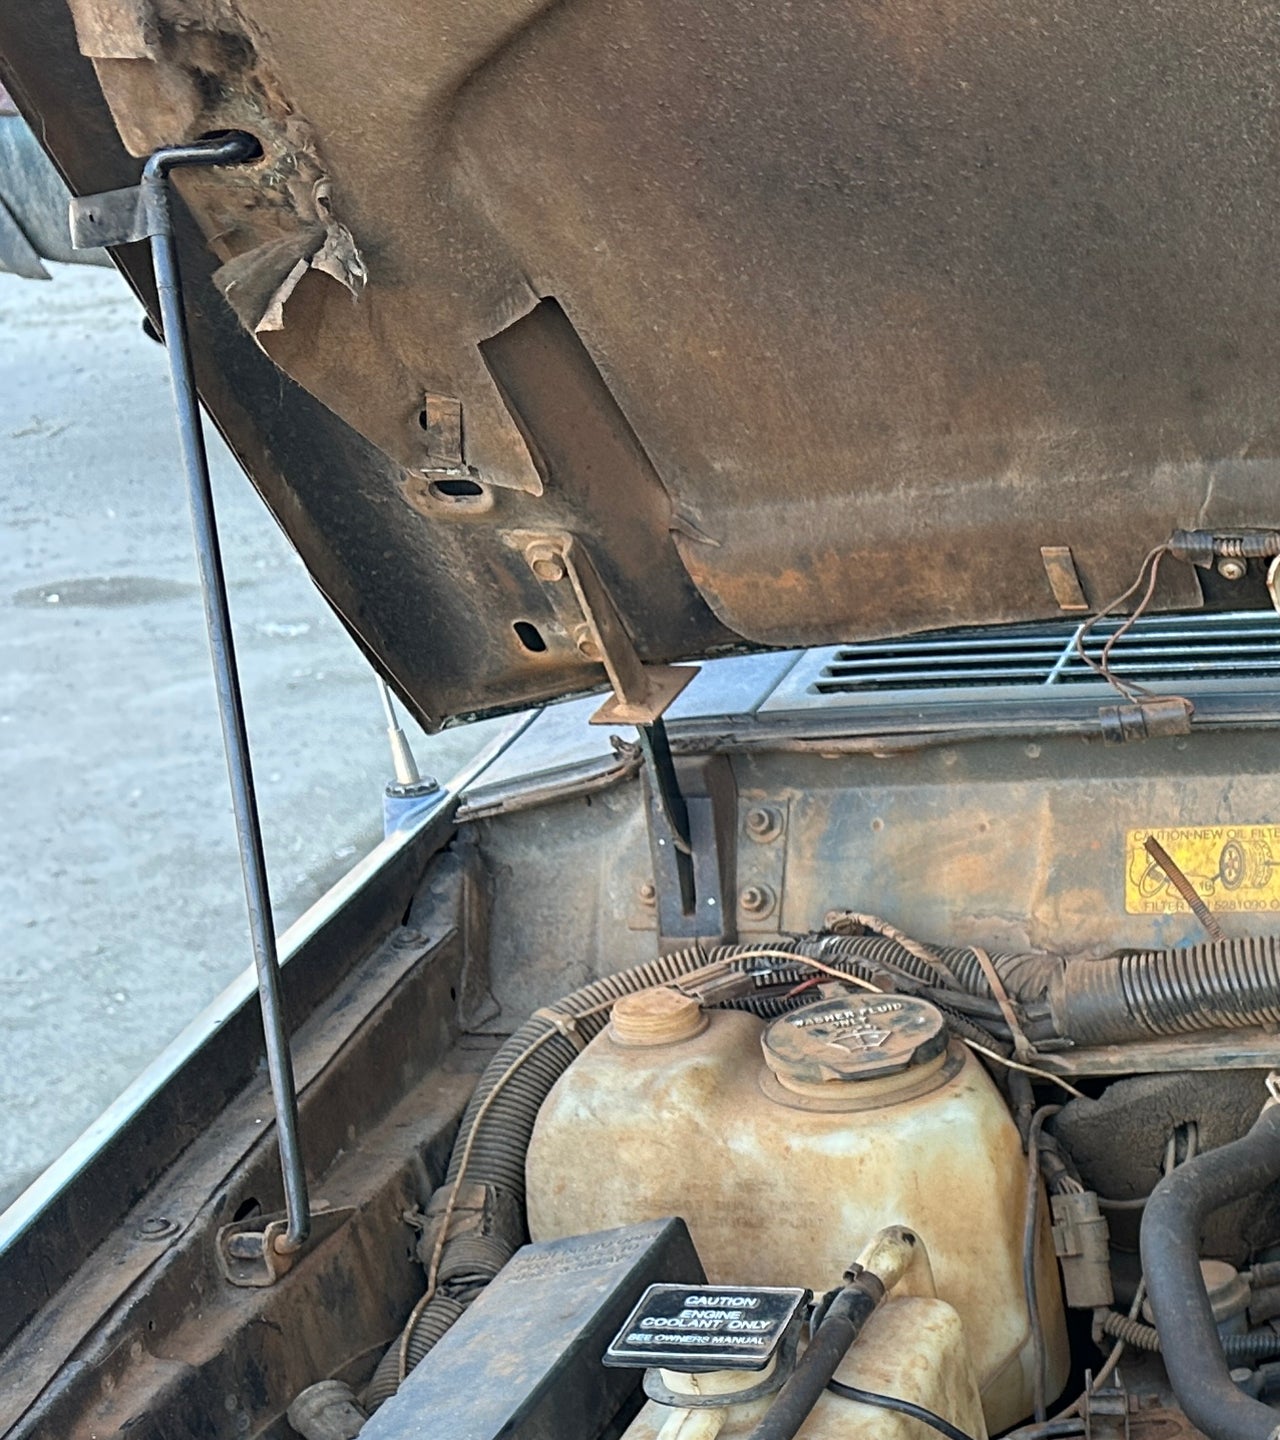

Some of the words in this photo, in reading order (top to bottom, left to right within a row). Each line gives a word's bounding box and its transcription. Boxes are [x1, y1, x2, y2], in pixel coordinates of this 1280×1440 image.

[1226, 828, 1246, 839] OIL
[1144, 901, 1184, 912] FILTER
[859, 1002, 902, 1017] FLUID
[684, 1296, 758, 1307] CAUTION
[680, 1310, 743, 1320] ENGINE
[640, 1318, 723, 1329] COOLANT
[727, 1320, 771, 1330] ONLY
[627, 1334, 652, 1342] SEE
[712, 1336, 765, 1345] MANUAL
